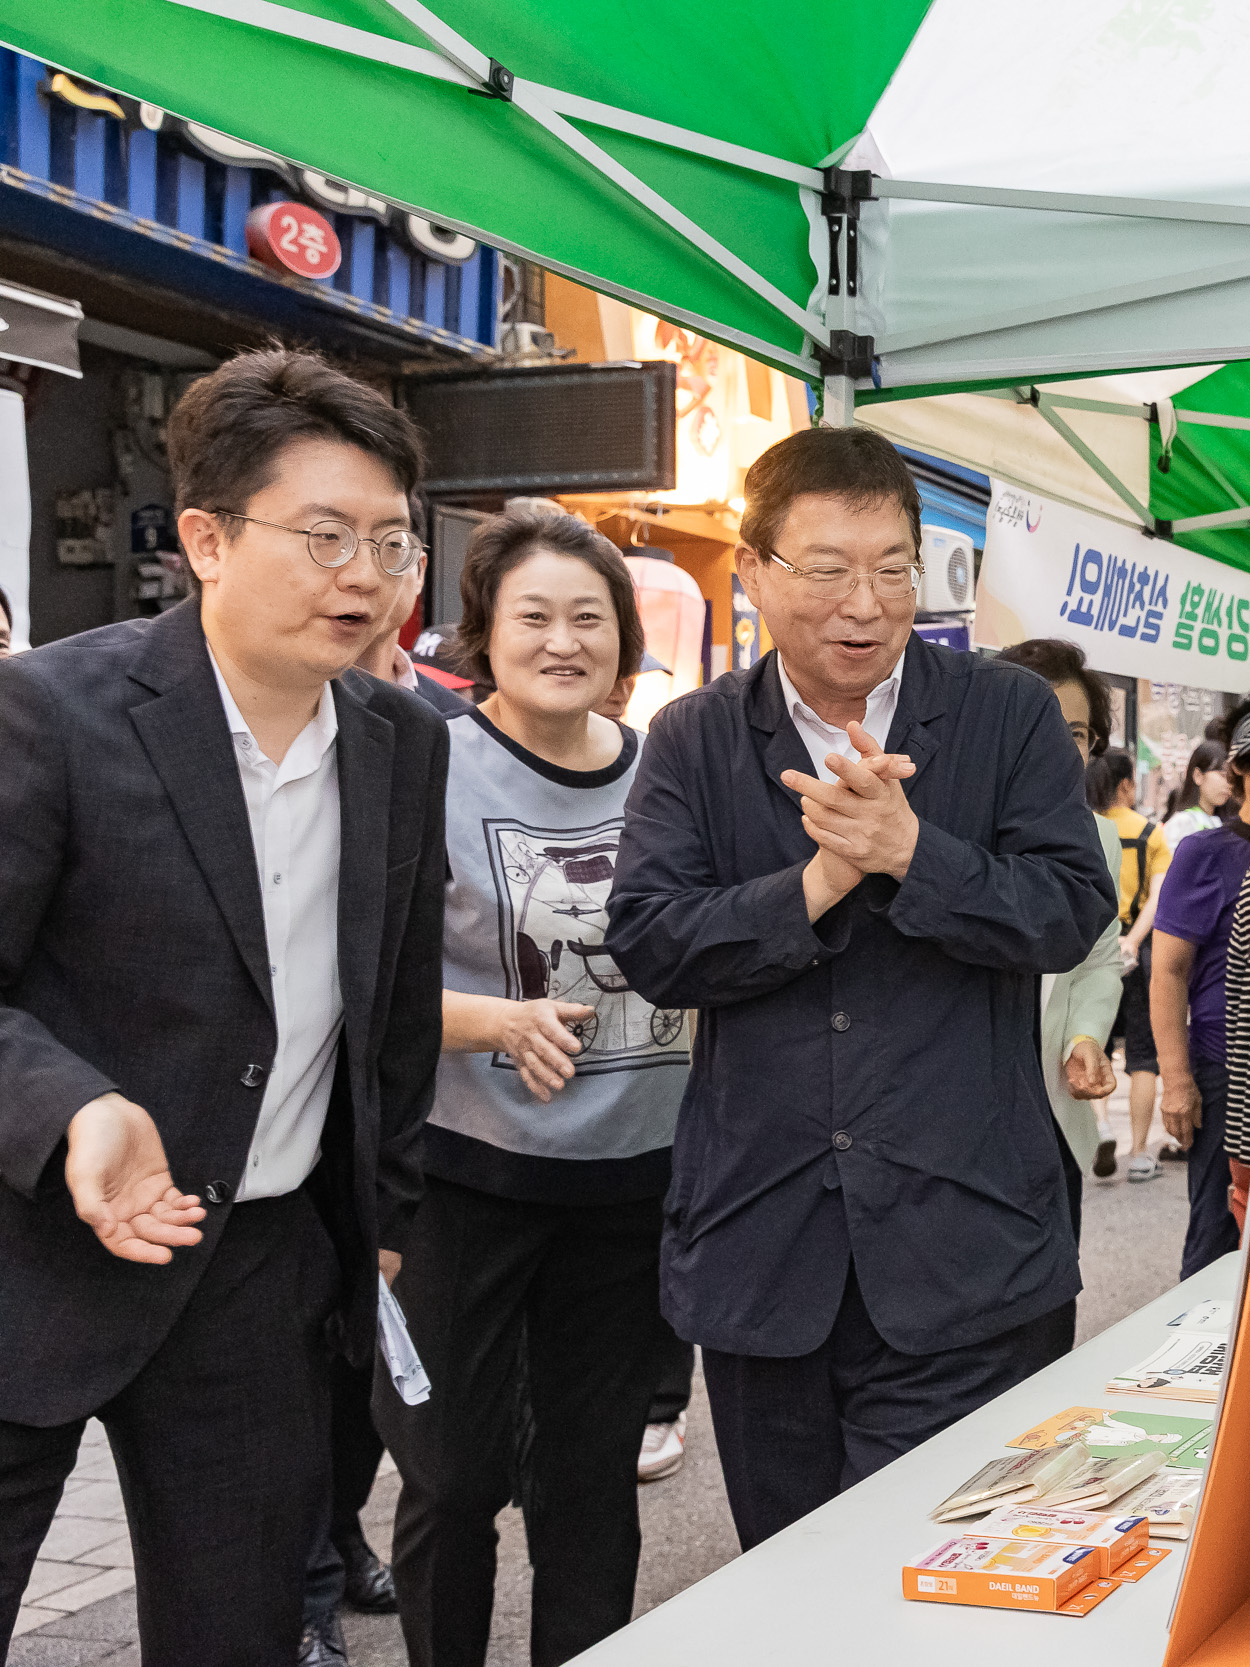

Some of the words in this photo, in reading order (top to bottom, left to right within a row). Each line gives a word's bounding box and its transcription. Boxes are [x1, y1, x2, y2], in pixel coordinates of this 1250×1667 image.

[279, 215, 328, 265] 2층
[989, 1581, 1013, 1592] DAEIL
[1015, 1584, 1040, 1594] BAND
